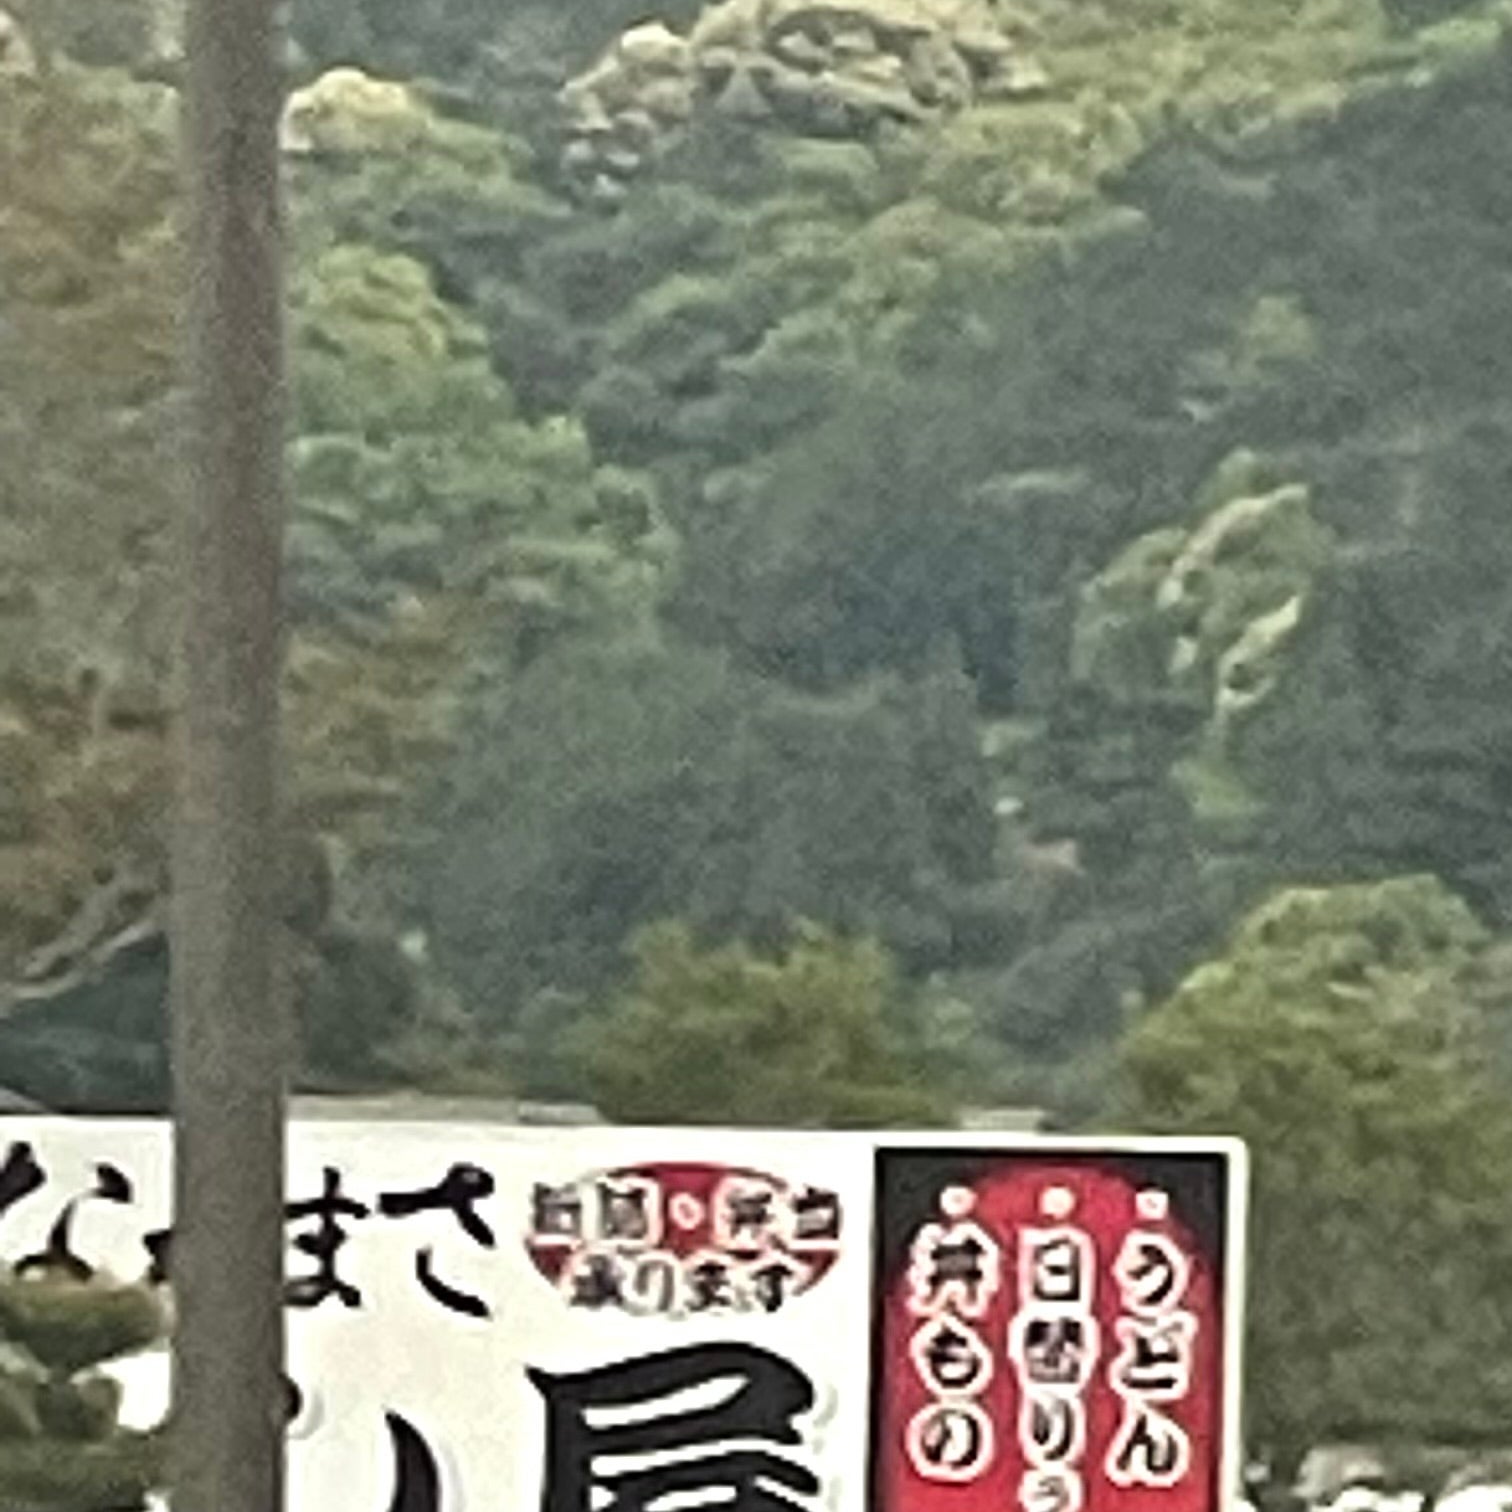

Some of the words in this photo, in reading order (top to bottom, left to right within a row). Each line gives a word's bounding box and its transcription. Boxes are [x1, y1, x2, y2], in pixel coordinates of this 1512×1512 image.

[0, 1140, 498, 1318] なまさ
[1114, 1240, 1192, 1476] うどん
